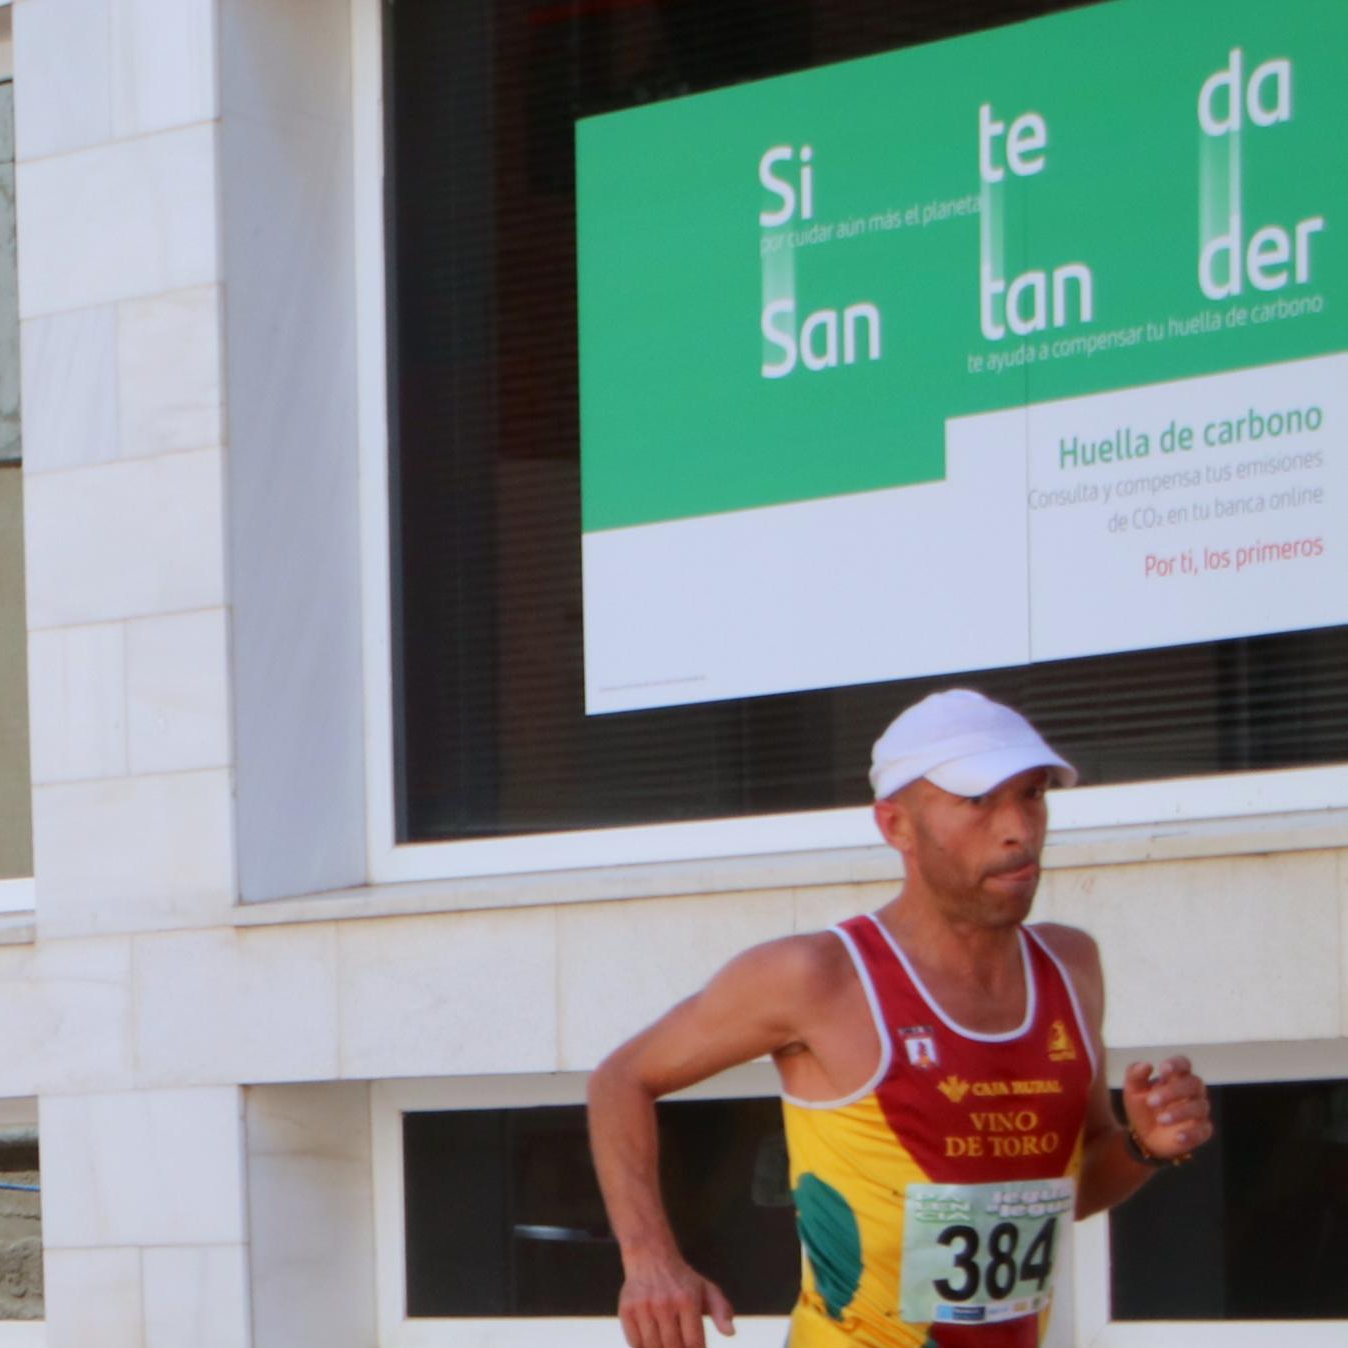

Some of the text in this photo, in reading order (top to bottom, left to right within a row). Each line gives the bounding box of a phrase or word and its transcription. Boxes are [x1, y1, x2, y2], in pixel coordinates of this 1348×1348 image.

[758, 47, 1293, 228] Si te da
[788, 222, 834, 249] cuidar
[836, 214, 866, 240] aún
[868, 207, 902, 233] más
[904, 203, 920, 226] el
[922, 193, 985, 226] planeta
[760, 213, 1325, 379] San tan der
[967, 294, 1324, 375] te ayuda a compensar tu huella de carbono
[1059, 405, 1324, 470] Huella de carbono
[1028, 450, 1325, 511] Consulta y compensa tus emisiones
[1107, 512, 1128, 534] de
[1166, 506, 1188, 525] en
[1191, 498, 1211, 522] tu
[1213, 492, 1266, 520] banca
[1268, 485, 1325, 511] online
[1144, 535, 1325, 578] Por ti, los primeros
[972, 1080, 1063, 1097] CAJA RURAL
[944, 1132, 1059, 1158] DE TORO
[969, 1111, 1038, 1132] VINO
[915, 1211, 971, 1223] CIA
[932, 1216, 1058, 1304] 384
